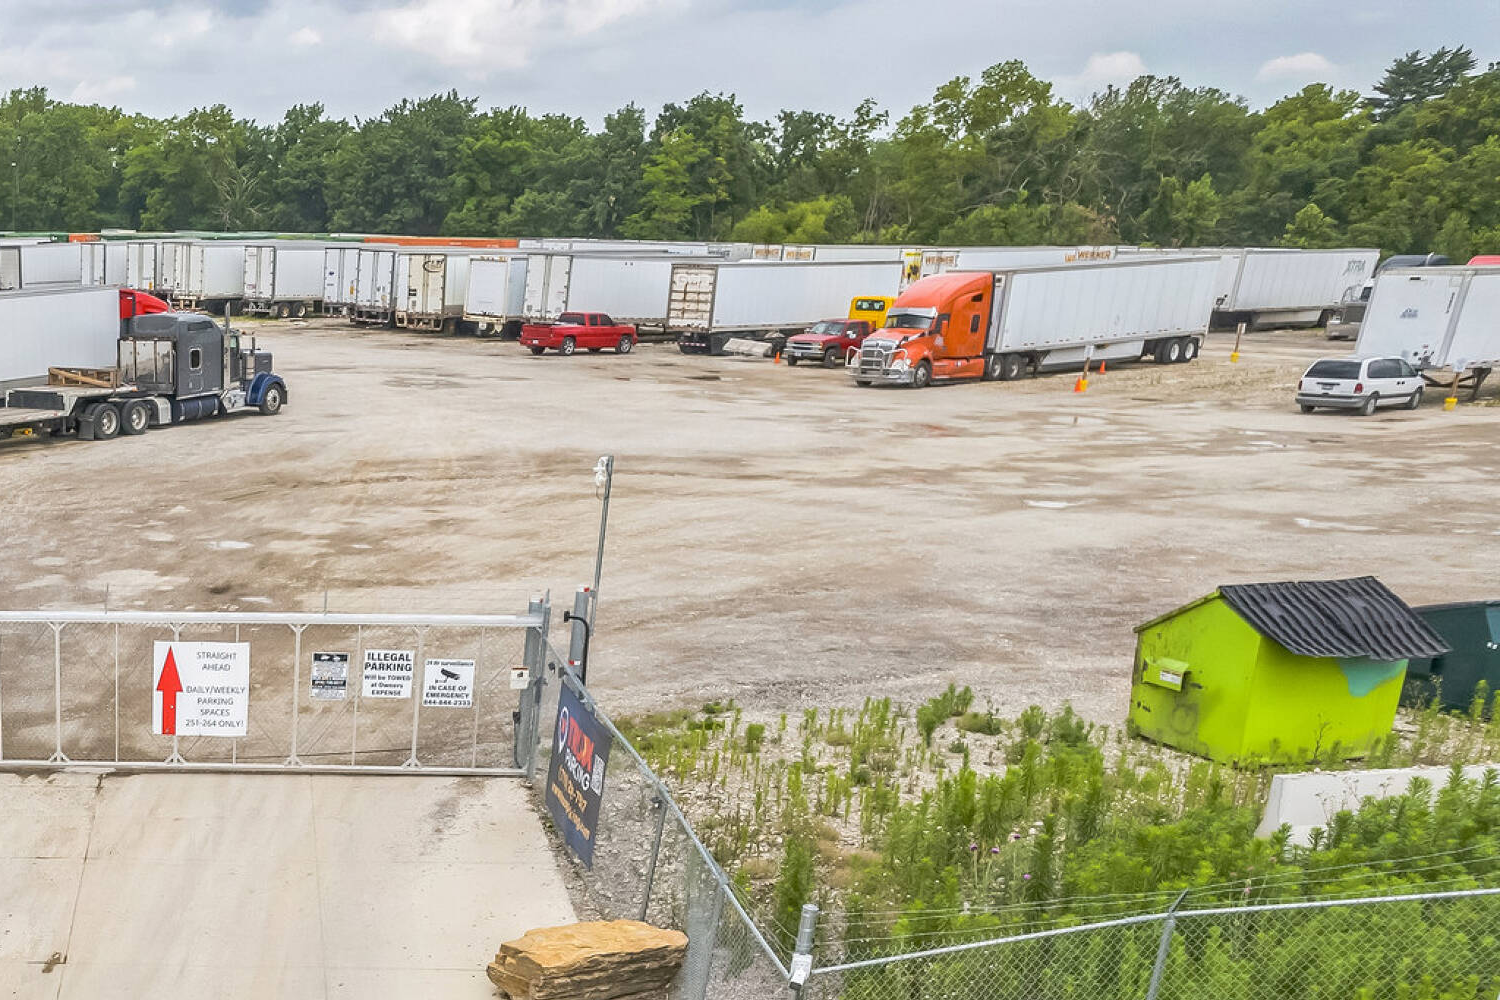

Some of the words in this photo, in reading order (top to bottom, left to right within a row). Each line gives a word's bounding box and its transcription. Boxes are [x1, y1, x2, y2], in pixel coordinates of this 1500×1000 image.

[196, 651, 237, 660] STRAIGHT
[367, 652, 412, 661] ILLEGAL
[202, 663, 231, 671] AHEAD
[364, 662, 412, 671] PARKING
[197, 697, 234, 705] PARKING
[200, 708, 230, 716] SPACES
